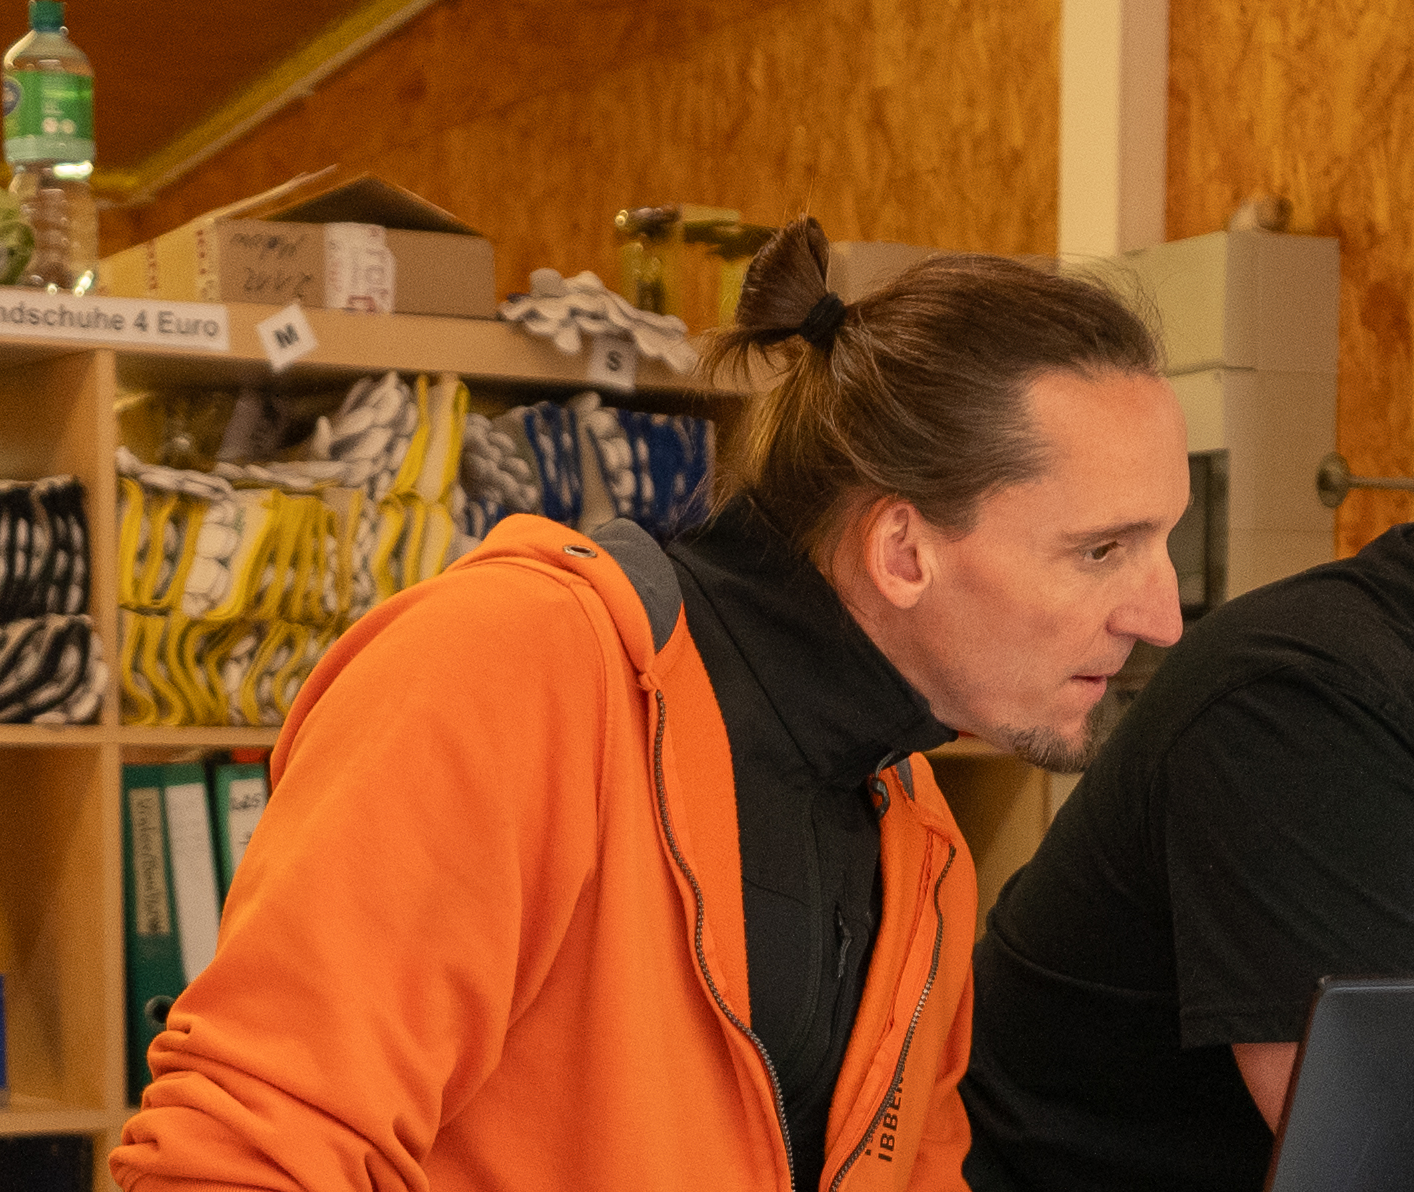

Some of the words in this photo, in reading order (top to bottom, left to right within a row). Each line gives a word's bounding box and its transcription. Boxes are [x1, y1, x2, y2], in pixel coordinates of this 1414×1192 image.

[134, 310, 148, 331] 4
[157, 311, 220, 337] Euro
[273, 323, 300, 349] M
[606, 350, 621, 372] S
